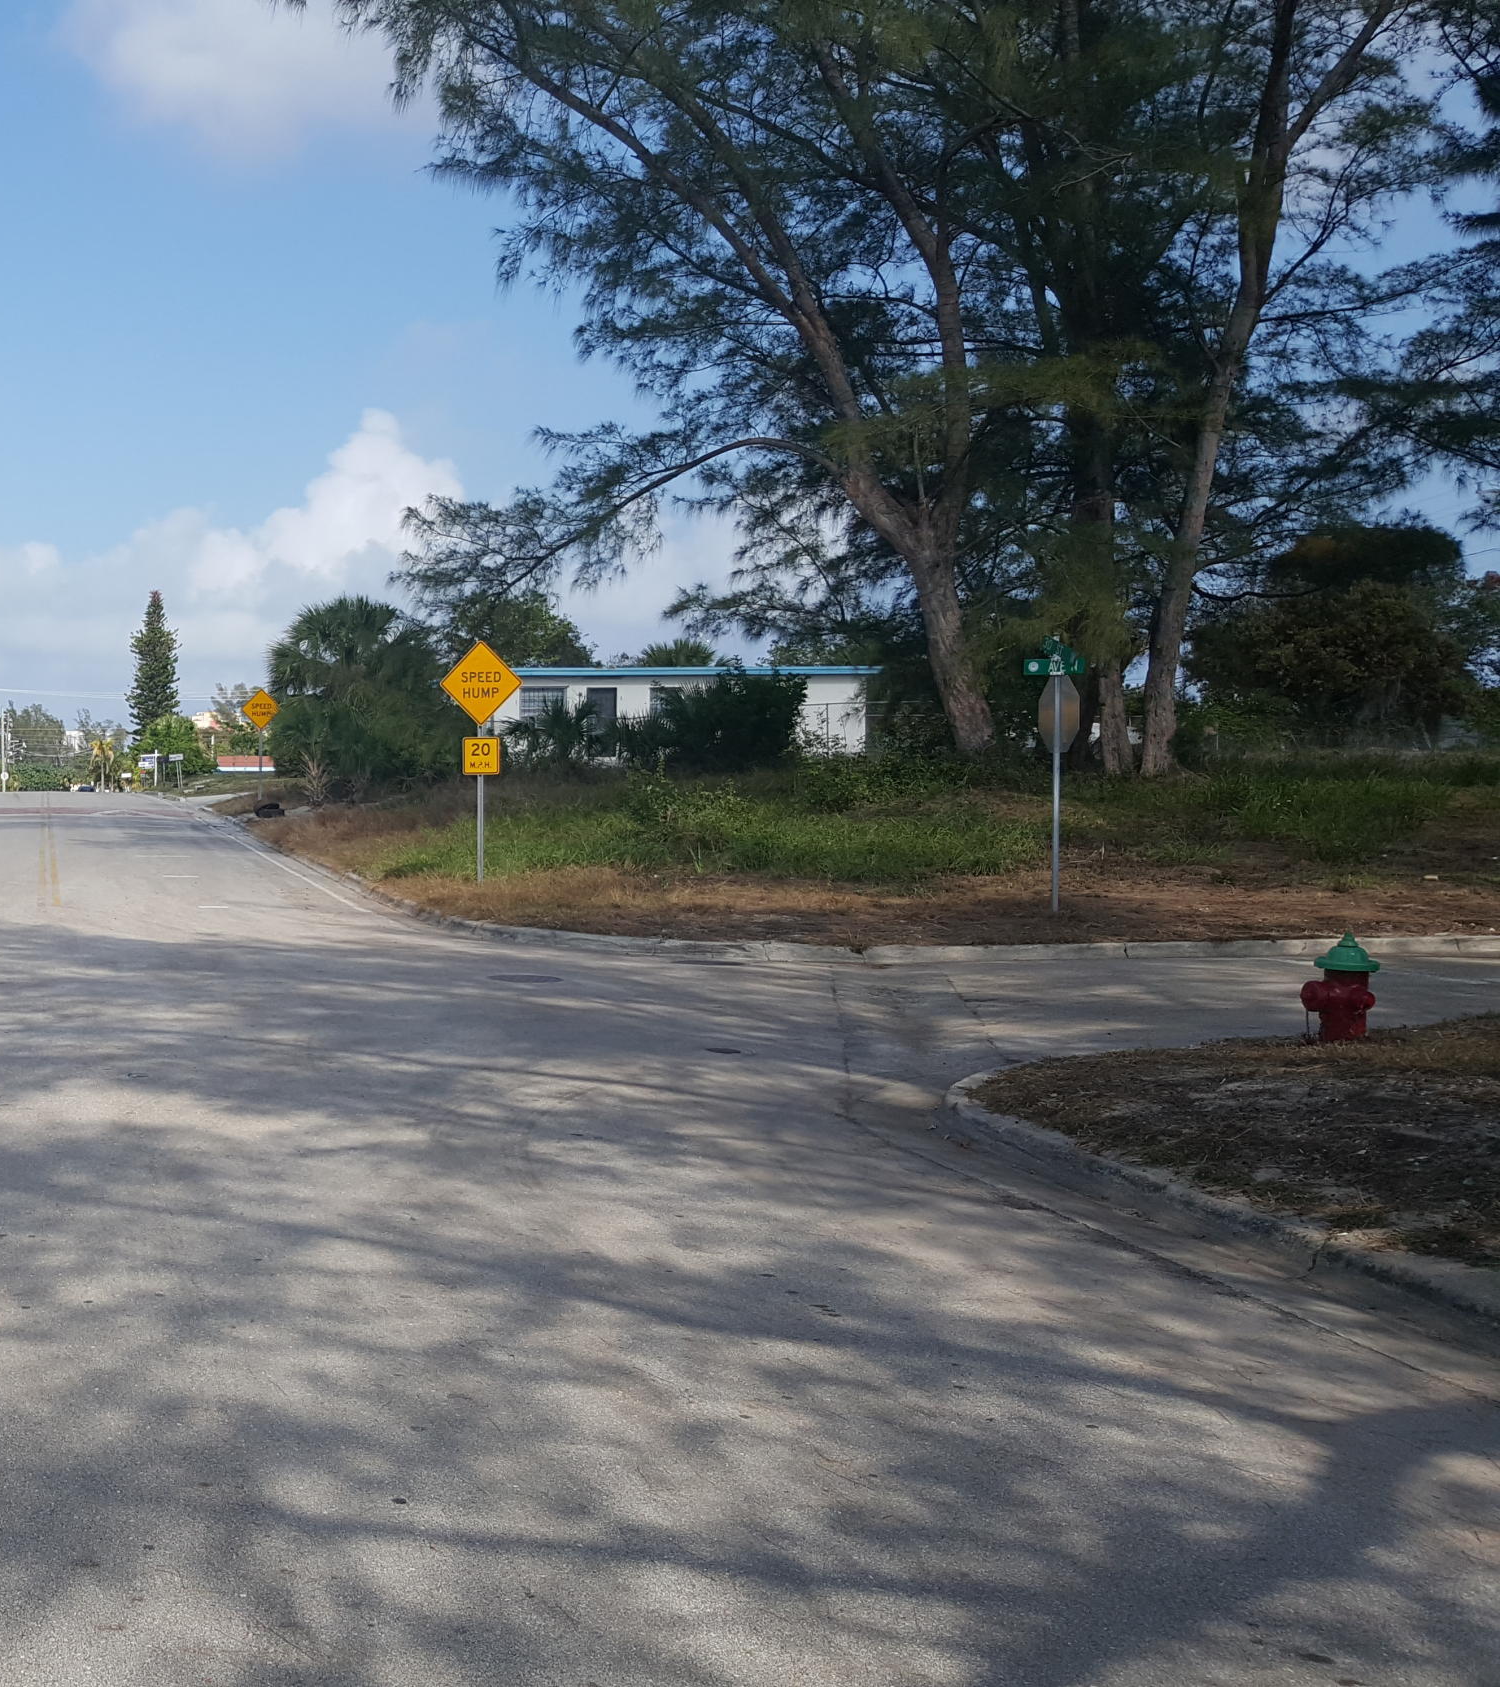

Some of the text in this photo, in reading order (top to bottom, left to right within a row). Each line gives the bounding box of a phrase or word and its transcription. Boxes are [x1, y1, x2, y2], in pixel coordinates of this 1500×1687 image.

[1048, 660, 1067, 673] AVE
[461, 672, 501, 683] SPEED
[463, 687, 499, 699] HUMP
[471, 743, 491, 757] 20
